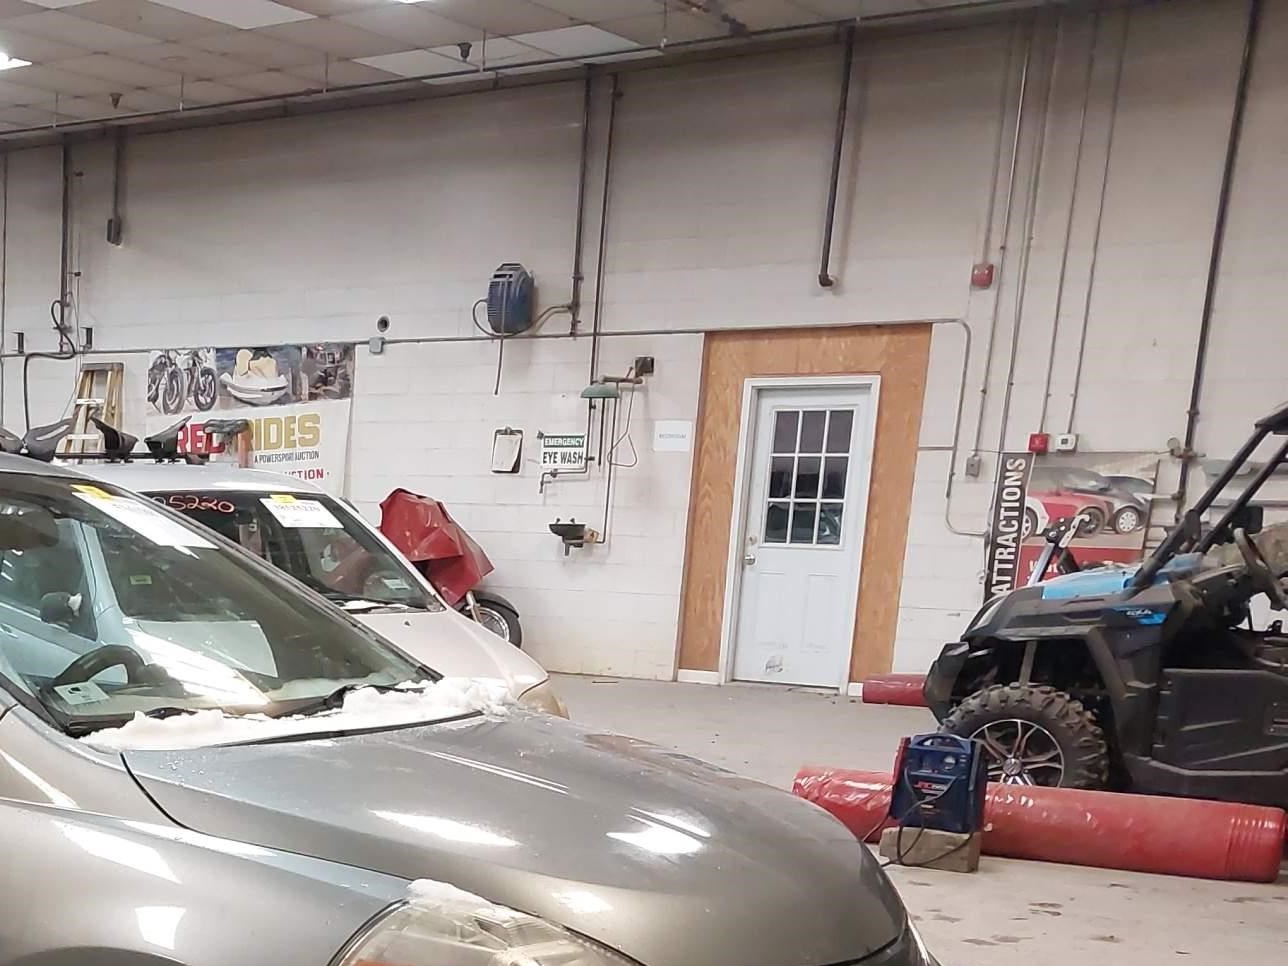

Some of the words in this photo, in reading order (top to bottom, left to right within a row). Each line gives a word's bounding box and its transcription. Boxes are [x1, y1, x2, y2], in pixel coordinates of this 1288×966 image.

[544, 437, 583, 446] EMERGENCY
[295, 450, 320, 461] AUCTION
[543, 451, 558, 463] EYE
[560, 451, 583, 463] WASH
[990, 458, 1027, 601] ATTRACTIONS
